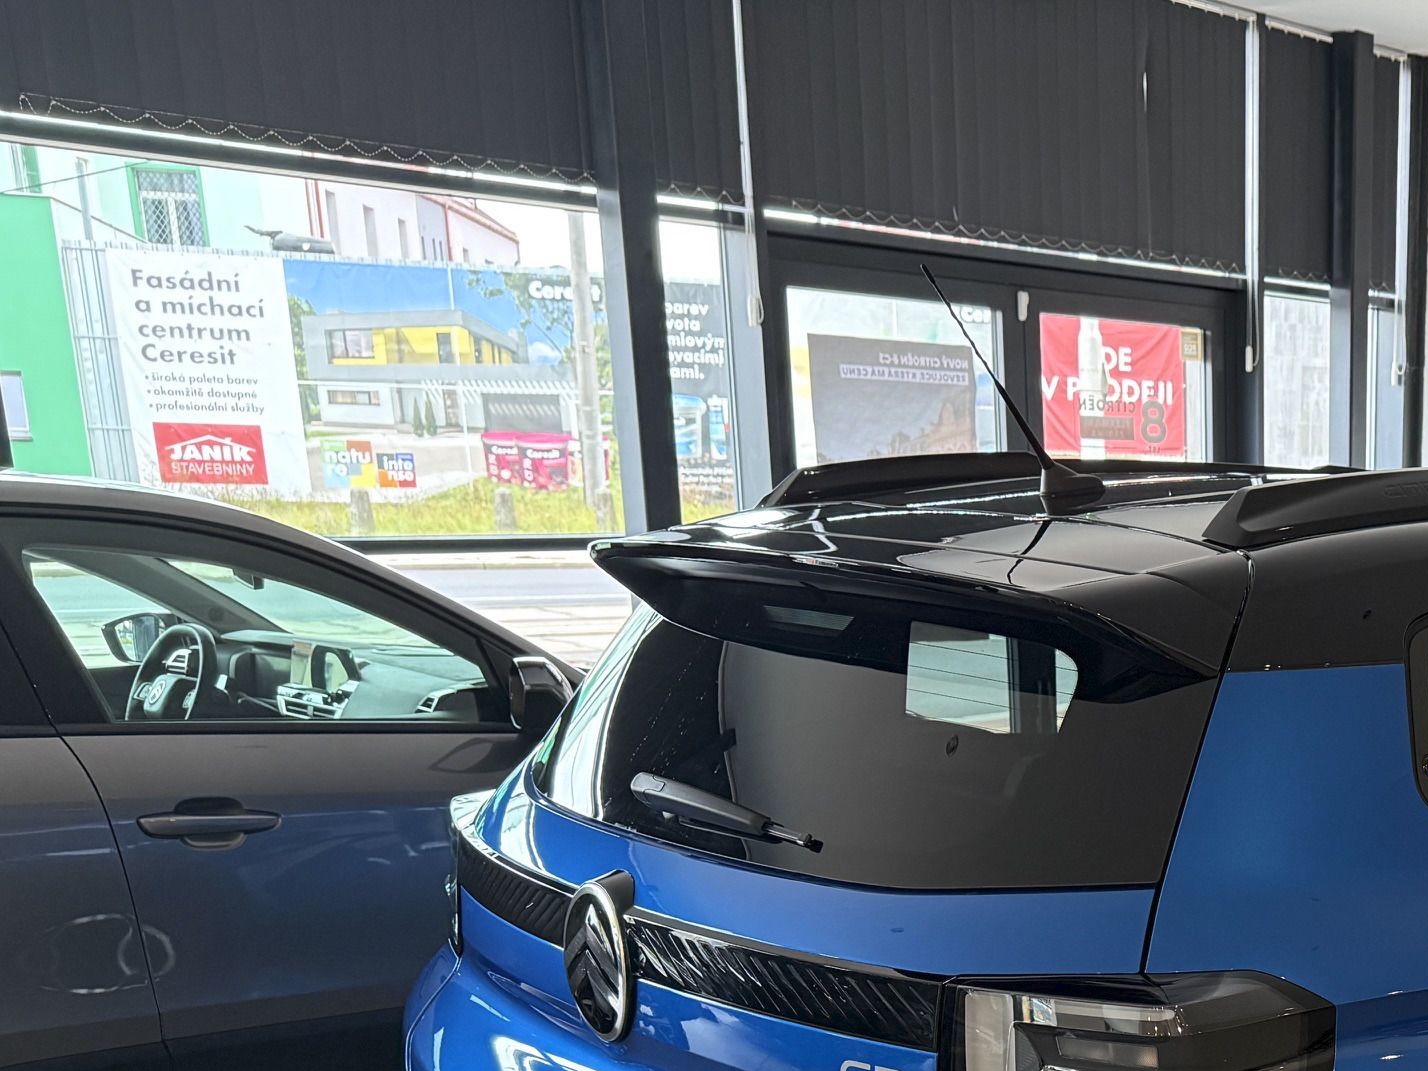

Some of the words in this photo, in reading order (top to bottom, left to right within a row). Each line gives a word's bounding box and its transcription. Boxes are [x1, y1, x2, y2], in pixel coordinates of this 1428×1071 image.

[131, 269, 241, 293] Fasádní
[528, 280, 601, 302] Ceret
[135, 299, 151, 313] a
[162, 295, 265, 318] míchací
[138, 323, 251, 342] centrum
[141, 343, 237, 365] Ceresit
[1100, 346, 1133, 372] DE
[189, 373, 224, 385] paleta
[227, 374, 258, 385] barev
[1041, 375, 1059, 401] V
[1067, 376, 1173, 406] PODEJI
[231, 402, 265, 415] služby
[171, 461, 255, 476] STAVEBNINY
